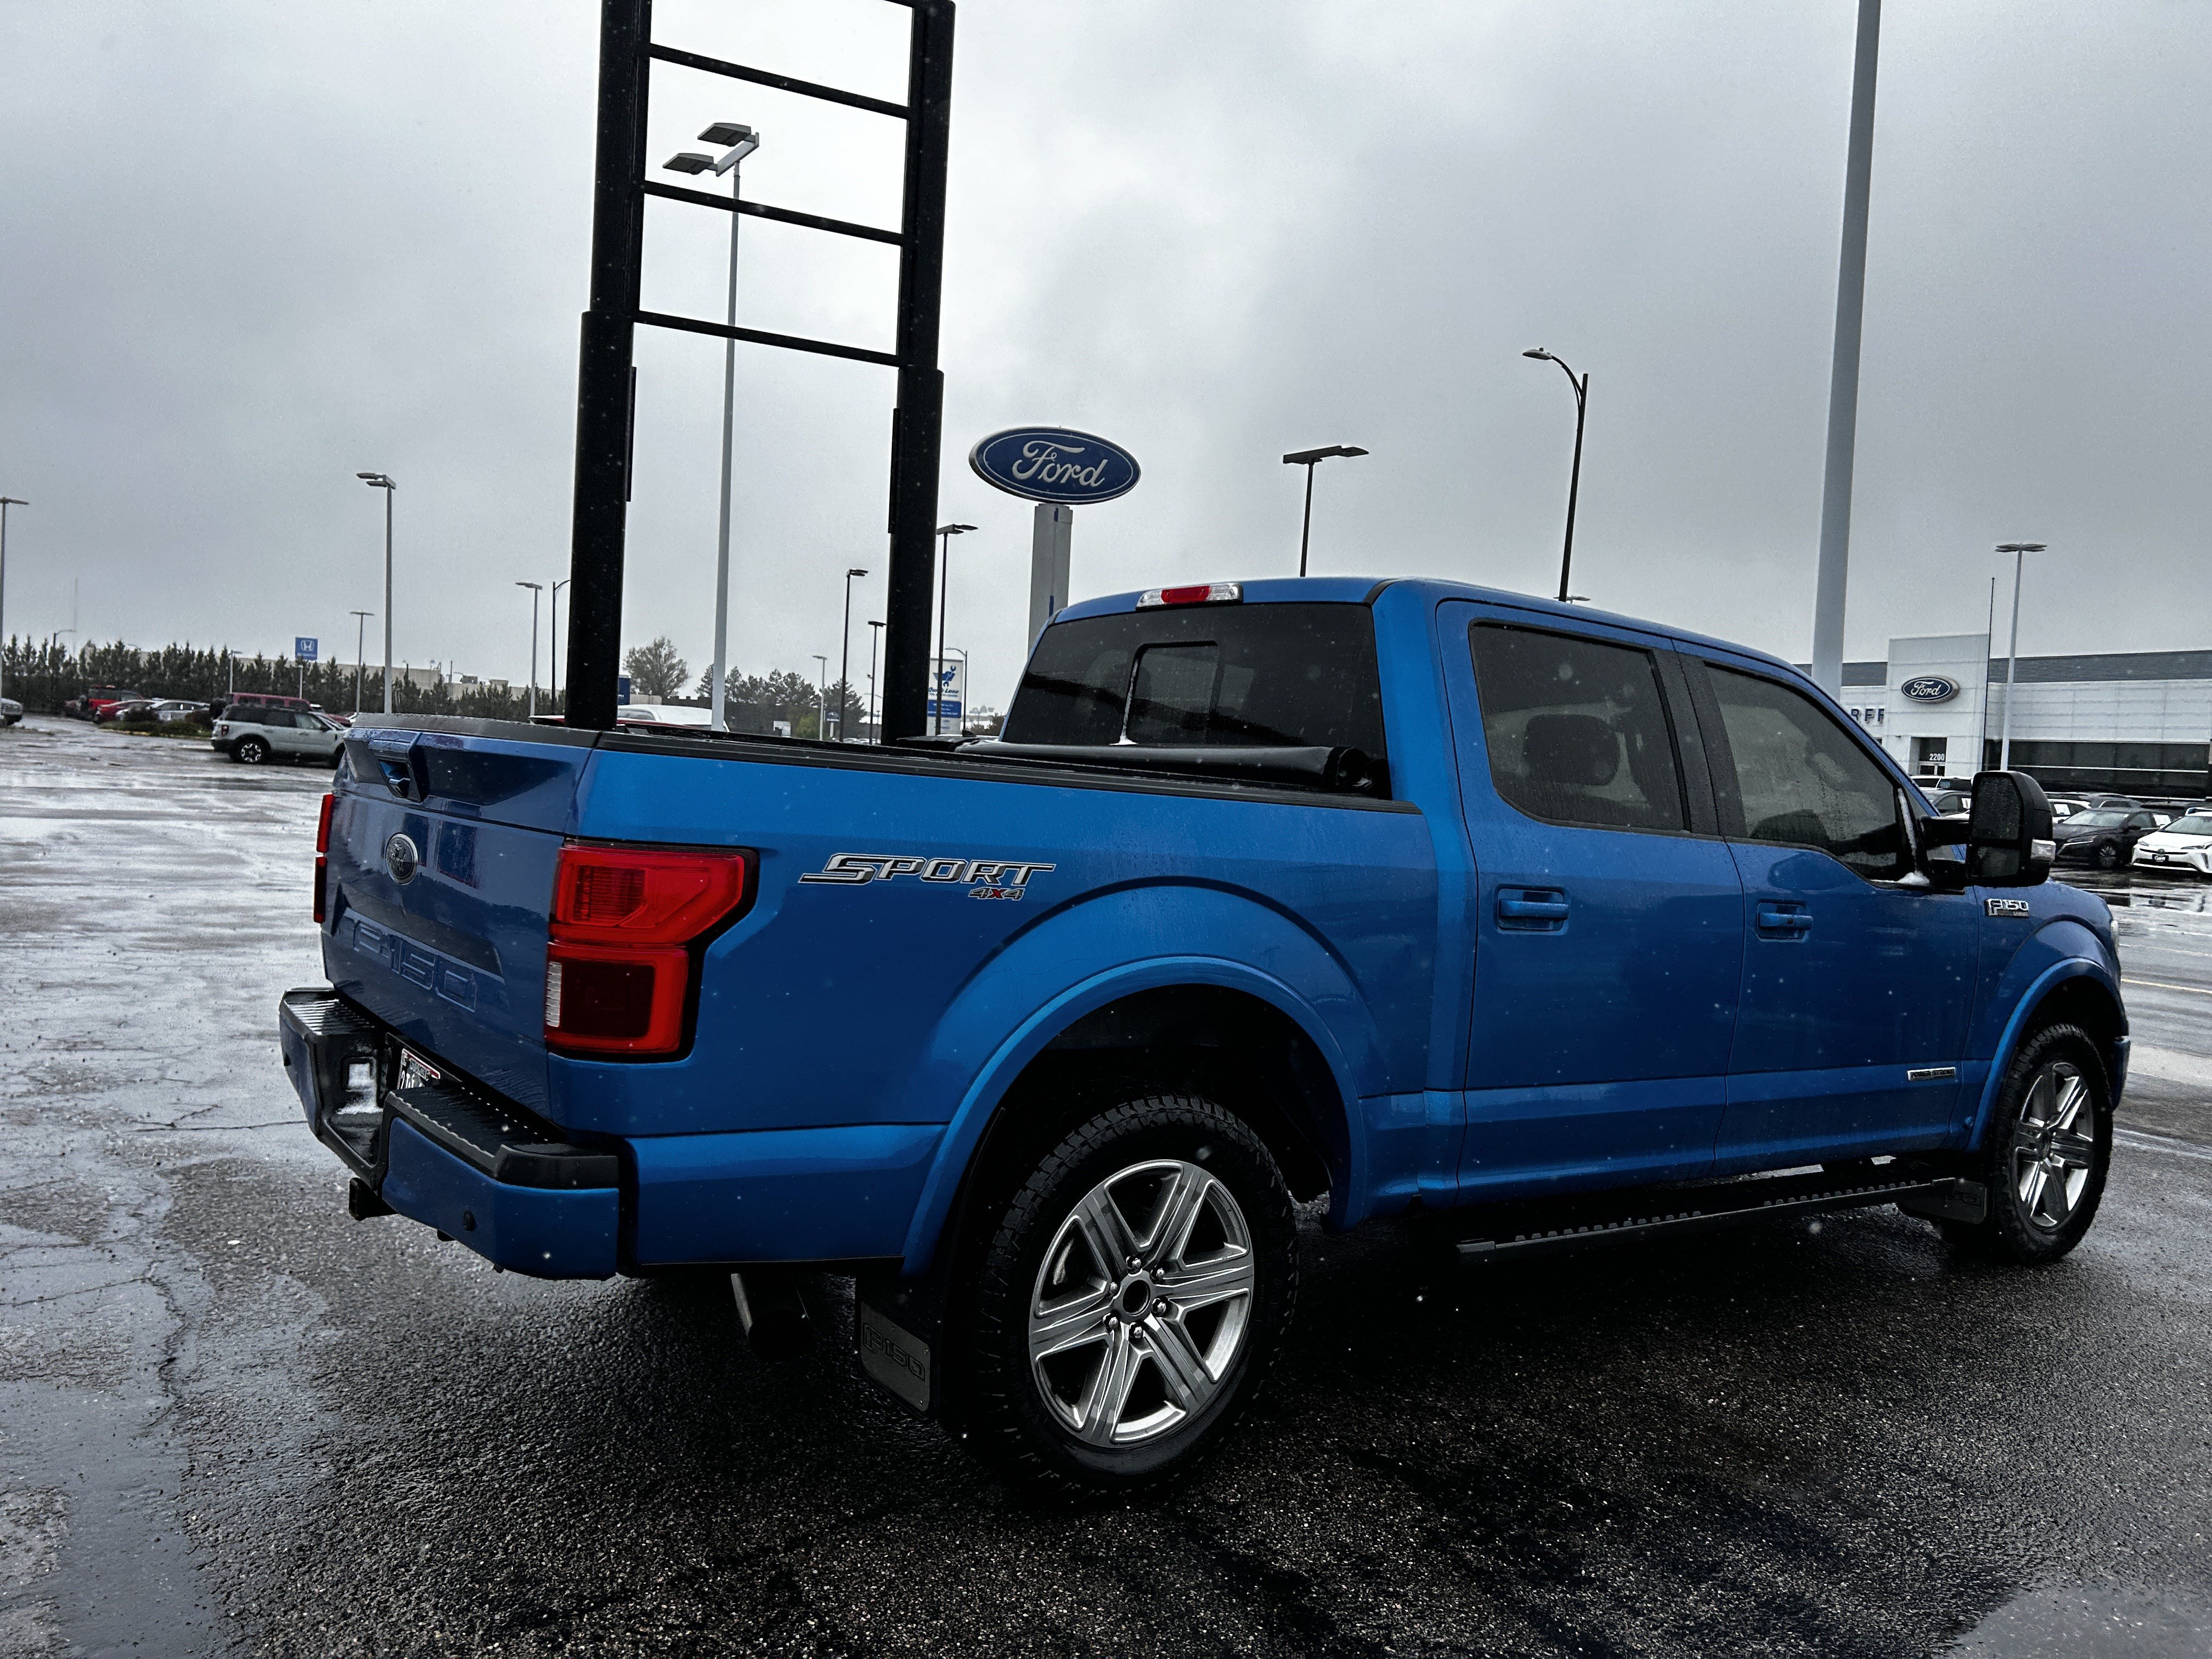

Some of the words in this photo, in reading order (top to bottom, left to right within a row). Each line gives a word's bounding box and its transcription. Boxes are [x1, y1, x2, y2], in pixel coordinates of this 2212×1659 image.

[1012, 440, 1109, 487] Ford
[1910, 681, 1941, 696] Ford
[798, 853, 1057, 887] SPORT
[862, 1323, 926, 1382] F150
